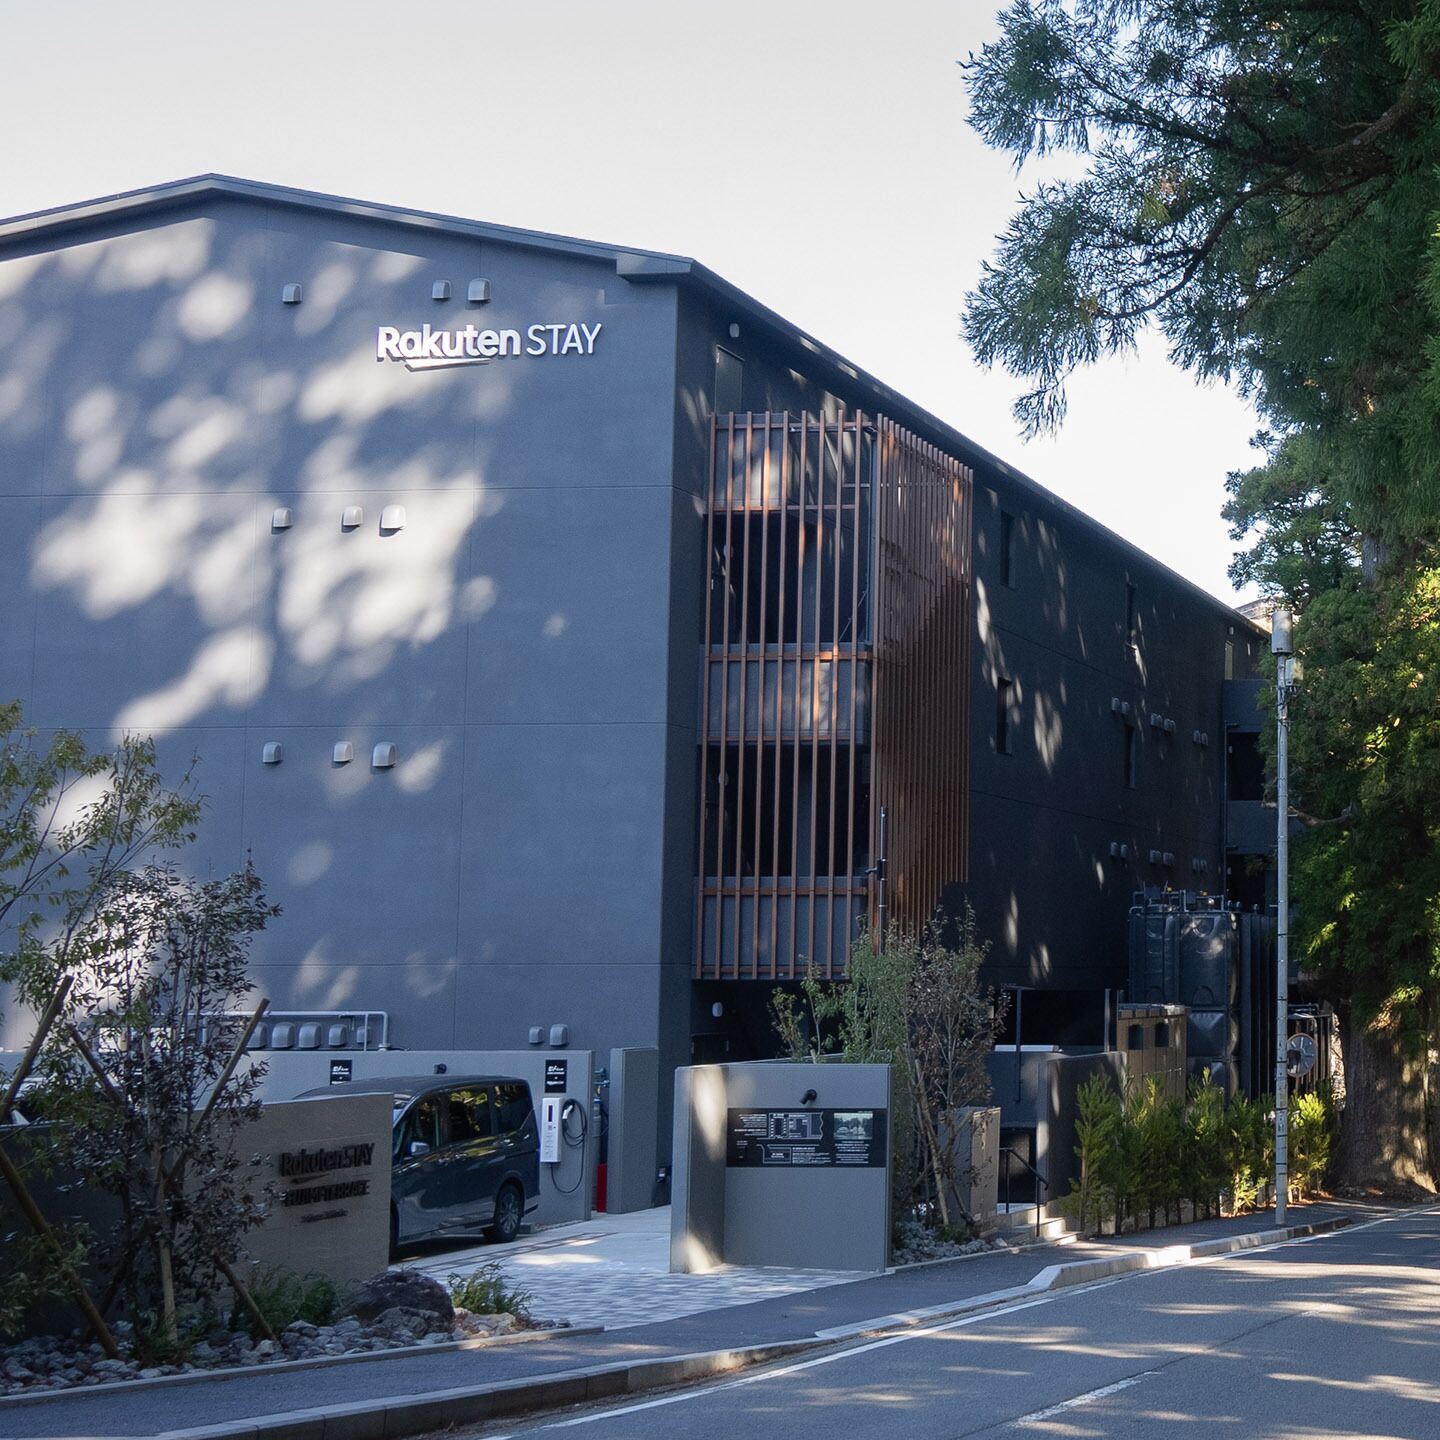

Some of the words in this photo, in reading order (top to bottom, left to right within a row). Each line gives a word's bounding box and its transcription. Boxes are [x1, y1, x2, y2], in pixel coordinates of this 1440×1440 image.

[377, 324, 520, 359] Rakuten
[526, 323, 602, 355] STAY
[280, 1149, 341, 1177] Rakuten
[342, 1143, 375, 1168] STAY
